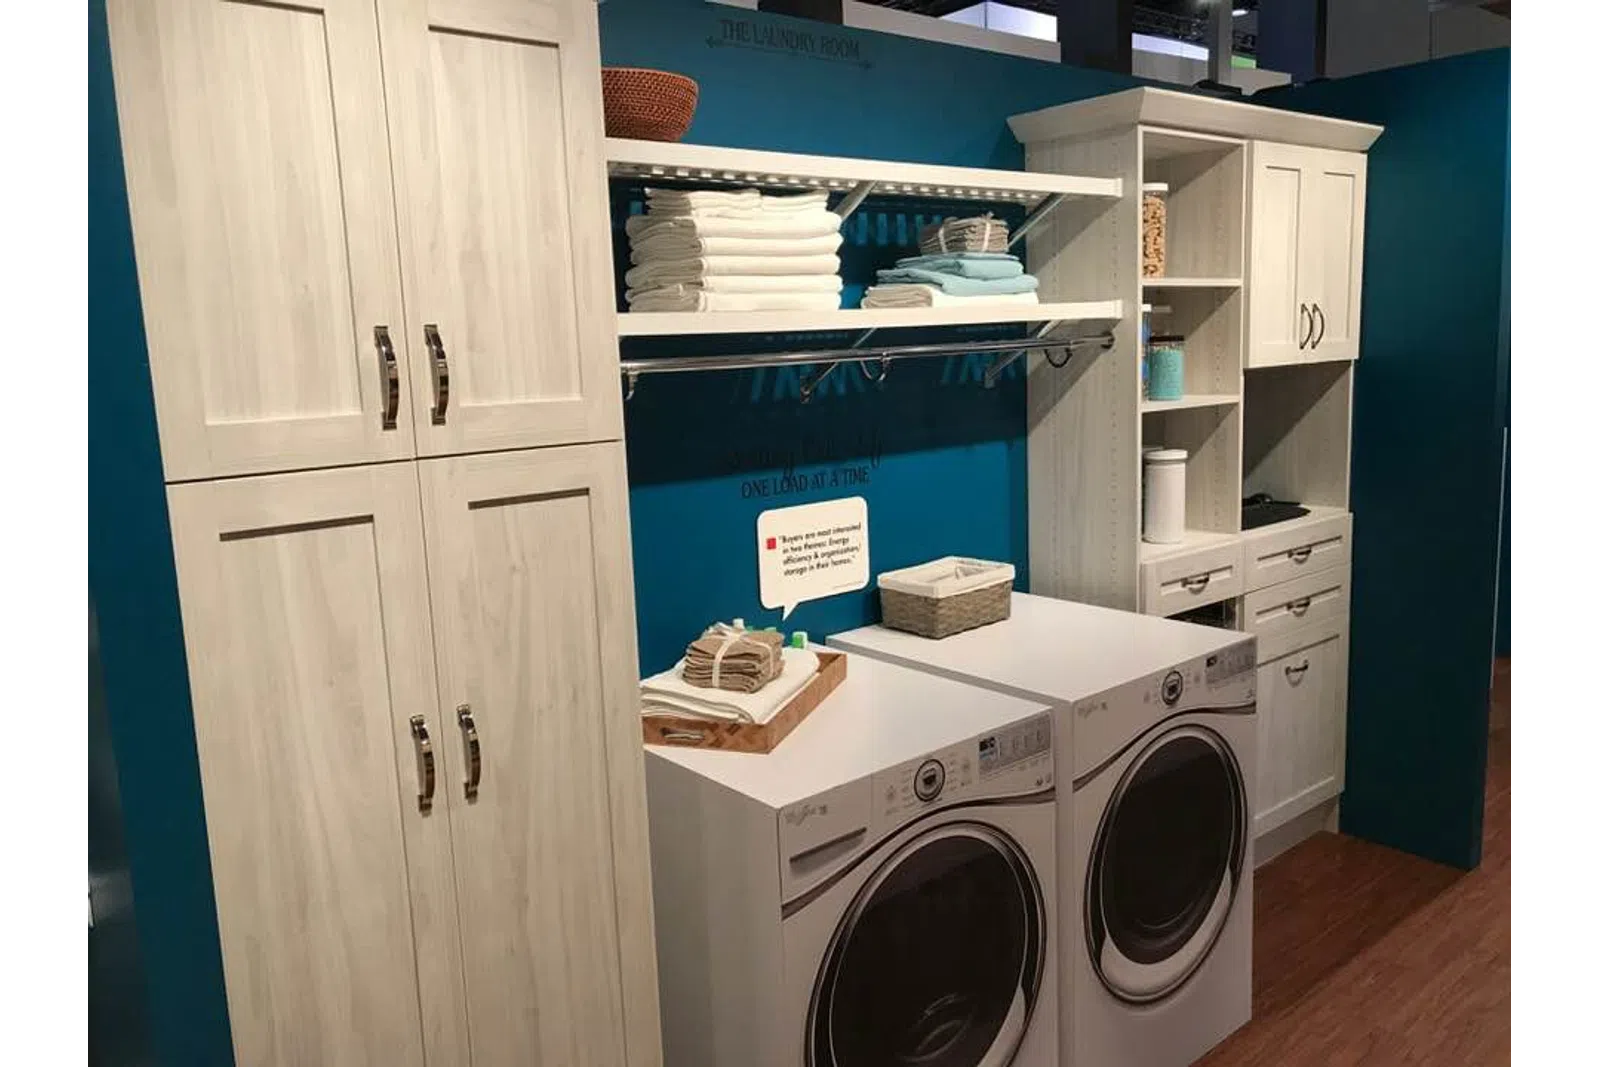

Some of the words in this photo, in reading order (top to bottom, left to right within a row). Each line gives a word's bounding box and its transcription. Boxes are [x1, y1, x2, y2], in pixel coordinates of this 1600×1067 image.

[742, 479, 769, 498] ONE
[773, 474, 808, 495] LOAD
[811, 471, 828, 489] AT
[829, 469, 839, 487] A
